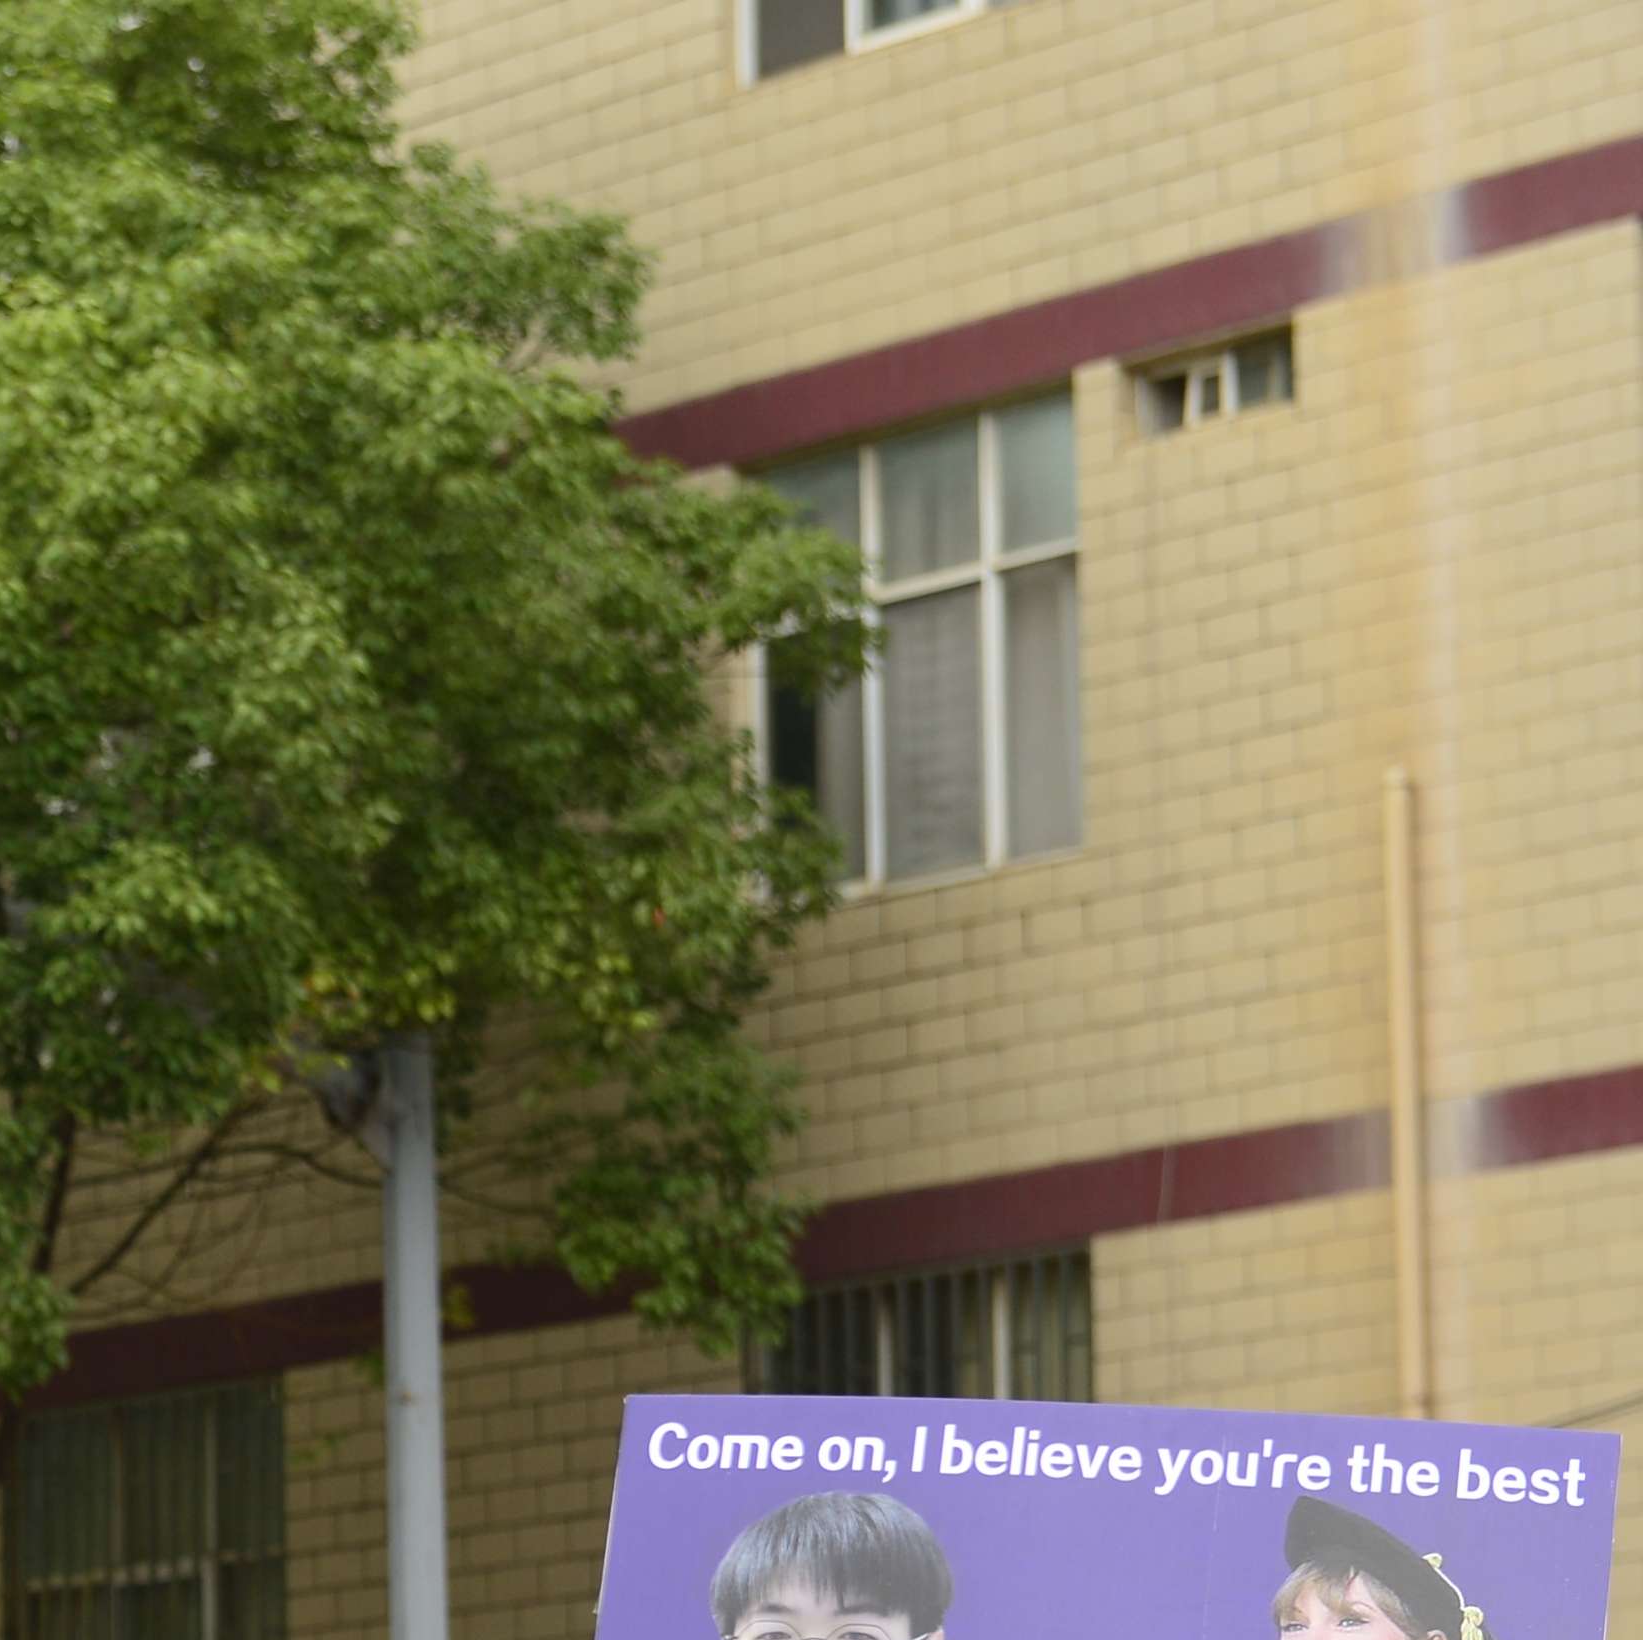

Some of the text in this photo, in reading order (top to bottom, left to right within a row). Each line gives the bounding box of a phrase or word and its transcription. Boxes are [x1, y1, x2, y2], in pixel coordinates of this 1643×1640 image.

[648, 1421, 1587, 1508] Come on, I believe you're the best
